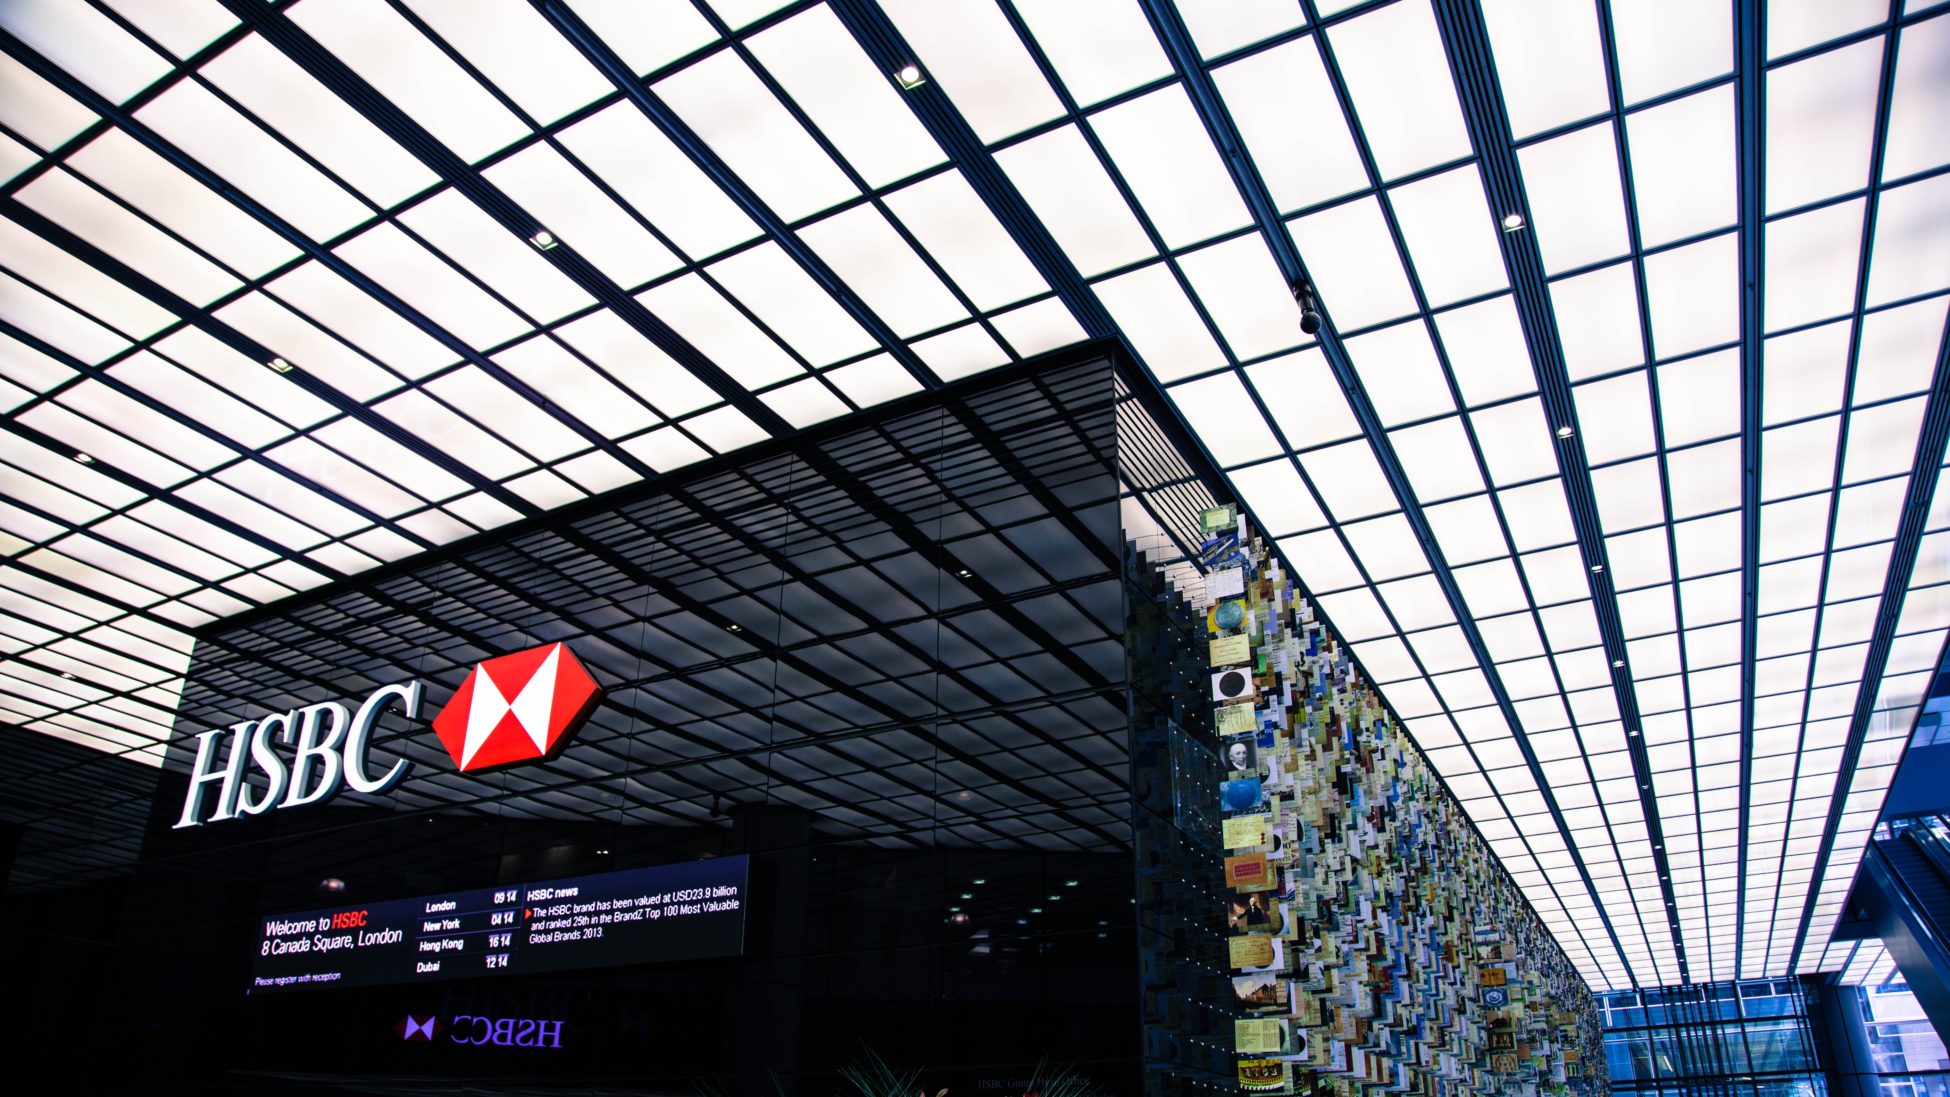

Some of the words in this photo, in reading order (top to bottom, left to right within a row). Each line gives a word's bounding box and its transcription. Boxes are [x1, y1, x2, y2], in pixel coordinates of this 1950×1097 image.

[172, 680, 423, 830] HSBC
[425, 900, 456, 913] London
[506, 890, 518, 902] 14
[527, 888, 554, 901] HSBC
[554, 887, 579, 899] news
[532, 907, 547, 918] The
[548, 904, 572, 916] HSBC
[573, 902, 595, 913] brand
[596, 900, 611, 911] has
[613, 898, 633, 909] been
[634, 894, 661, 906] valued
[662, 893, 671, 904] at
[672, 887, 711, 902] USD23.9
[712, 886, 737, 898] billion
[266, 919, 316, 937] Welcome
[319, 917, 330, 931] to
[331, 910, 368, 929] HSBC
[423, 921, 441, 932] New
[442, 918, 461, 930] York
[491, 912, 502, 926] 04
[503, 911, 515, 924] 14
[531, 920, 545, 931] and
[545, 918, 572, 930] ranked
[573, 915, 590, 927] 25th
[590, 914, 599, 924] in
[599, 913, 612, 924] the
[613, 909, 644, 922] BrandZ
[645, 908, 661, 920] Top
[663, 905, 679, 917] 100
[679, 904, 701, 915] Most
[702, 899, 740, 913] Valuable
[261, 940, 270, 956] 8
[271, 937, 311, 955] Canada
[312, 934, 355, 953] Square,
[358, 927, 402, 946] London
[419, 941, 441, 953] Hong
[441, 939, 464, 951] Kong
[488, 934, 500, 948] 16
[501, 933, 512, 947] 14
[529, 932, 553, 944] Global
[553, 930, 581, 942] Brands
[416, 961, 440, 973] Dubai
[485, 955, 497, 968] 12
[498, 953, 510, 968] 14
[255, 977, 274, 986] Please
[312, 972, 341, 983] reception
